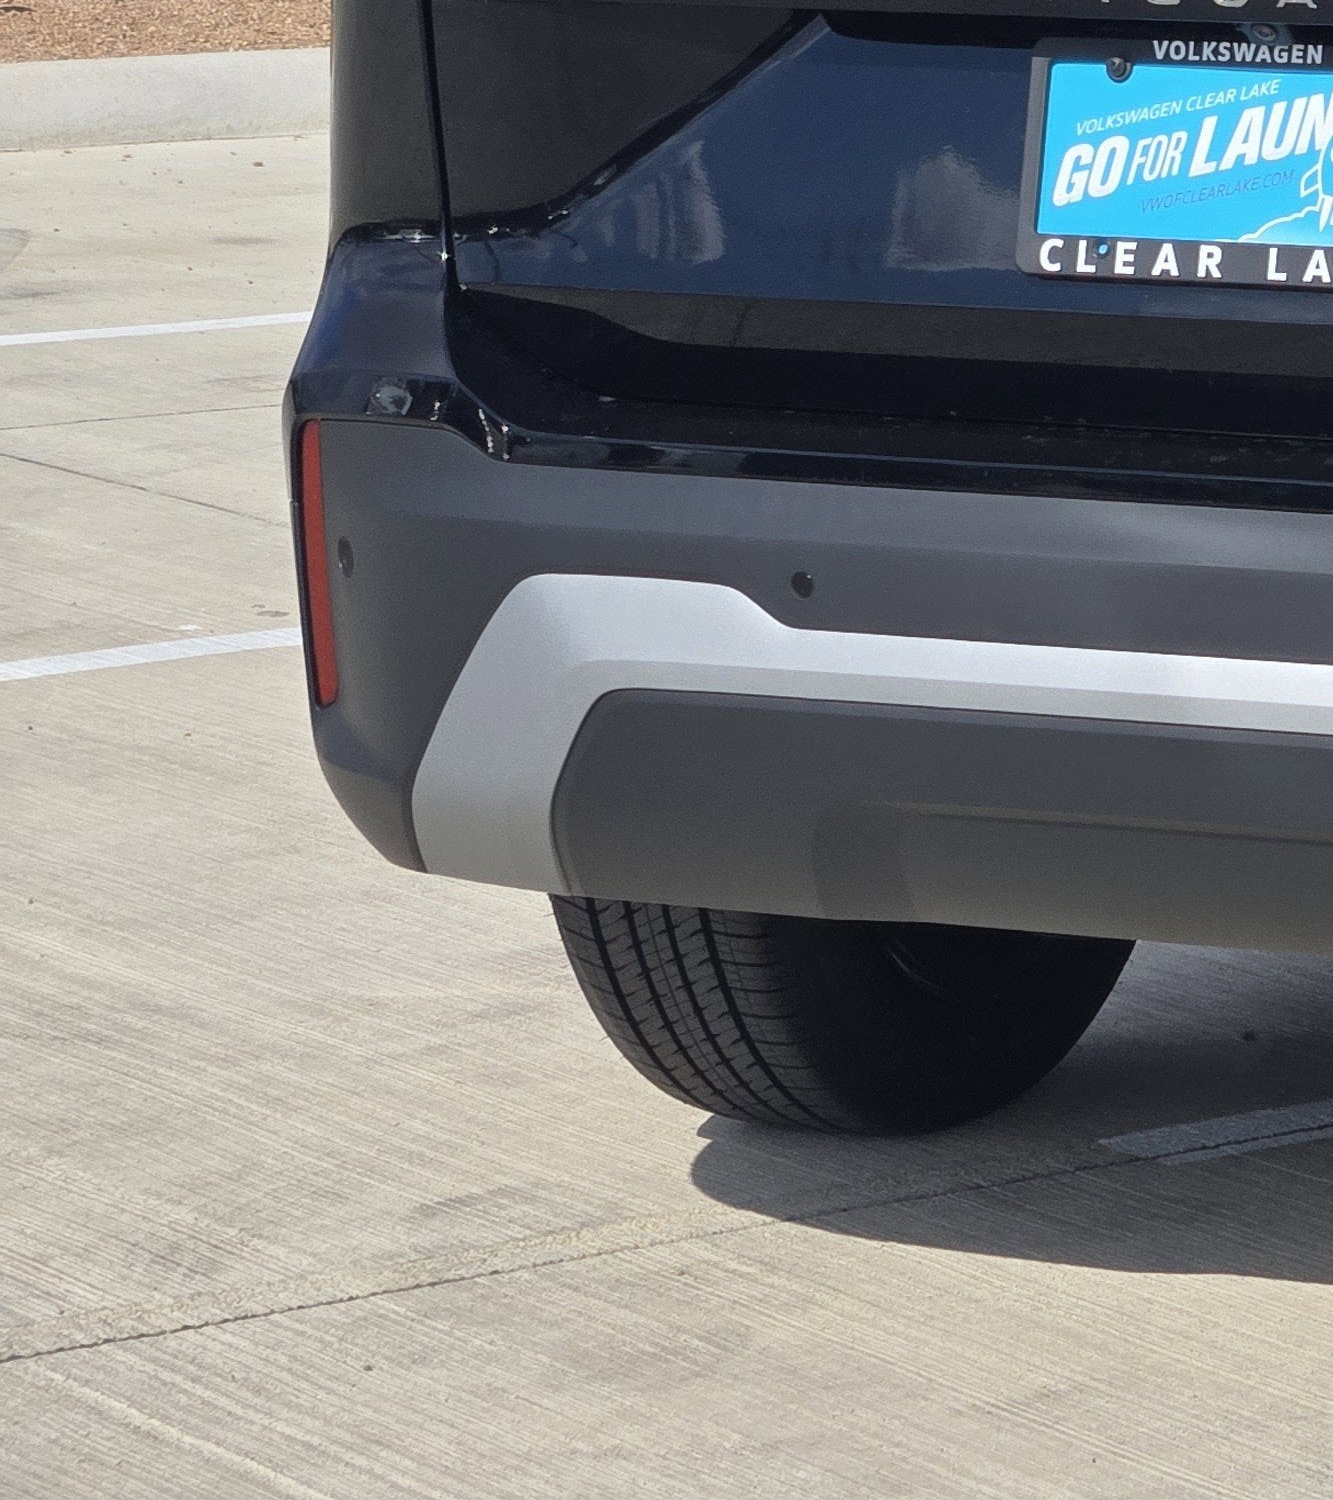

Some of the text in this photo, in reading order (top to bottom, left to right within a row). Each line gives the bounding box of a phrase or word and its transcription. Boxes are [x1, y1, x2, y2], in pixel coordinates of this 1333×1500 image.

[1153, 39, 1324, 65] VOLKSWAGEN
[1075, 78, 1282, 136] VOLKSWAGEN CLEAR LAKE
[1052, 134, 1130, 208] GO
[1126, 130, 1189, 186] FOR
[1140, 170, 1295, 214] VWOFCLEARLAKE.COM
[1038, 238, 1224, 279] CLEAR
